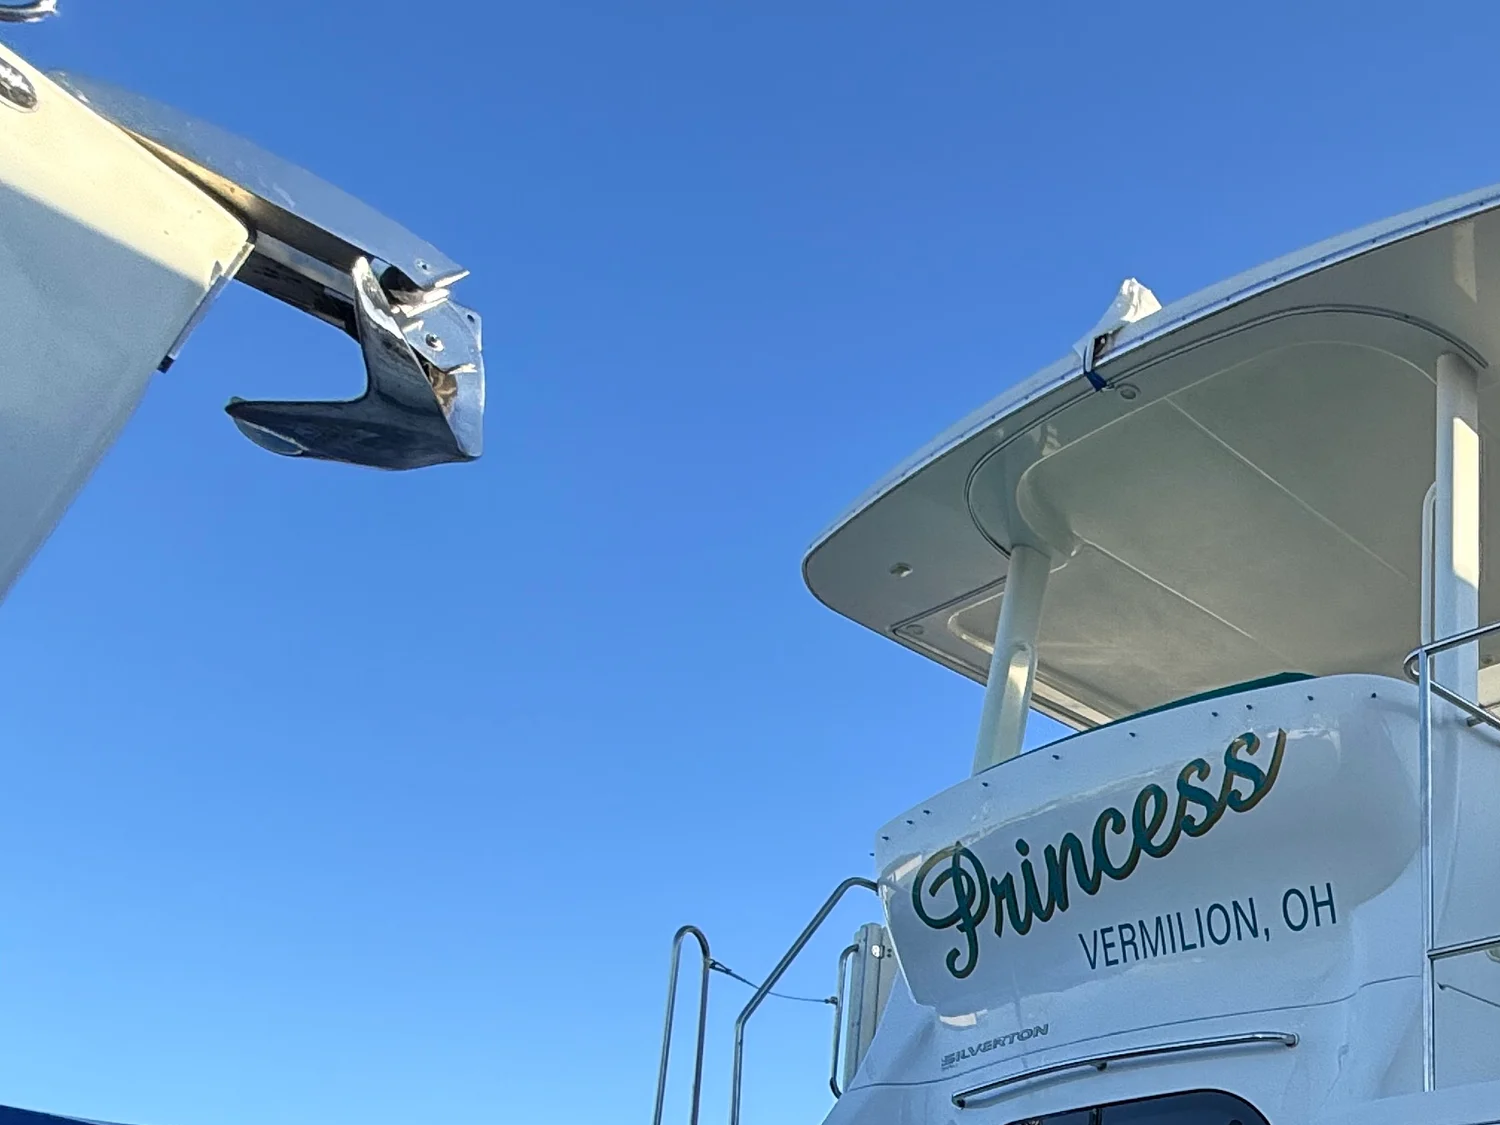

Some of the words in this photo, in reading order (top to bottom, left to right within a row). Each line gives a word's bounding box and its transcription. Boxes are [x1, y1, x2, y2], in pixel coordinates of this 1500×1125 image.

[912, 728, 1287, 979] Princess
[1078, 897, 1270, 970] VERMILION,
[1282, 882, 1337, 932] OH
[941, 1024, 1049, 1067] SILVERTON
